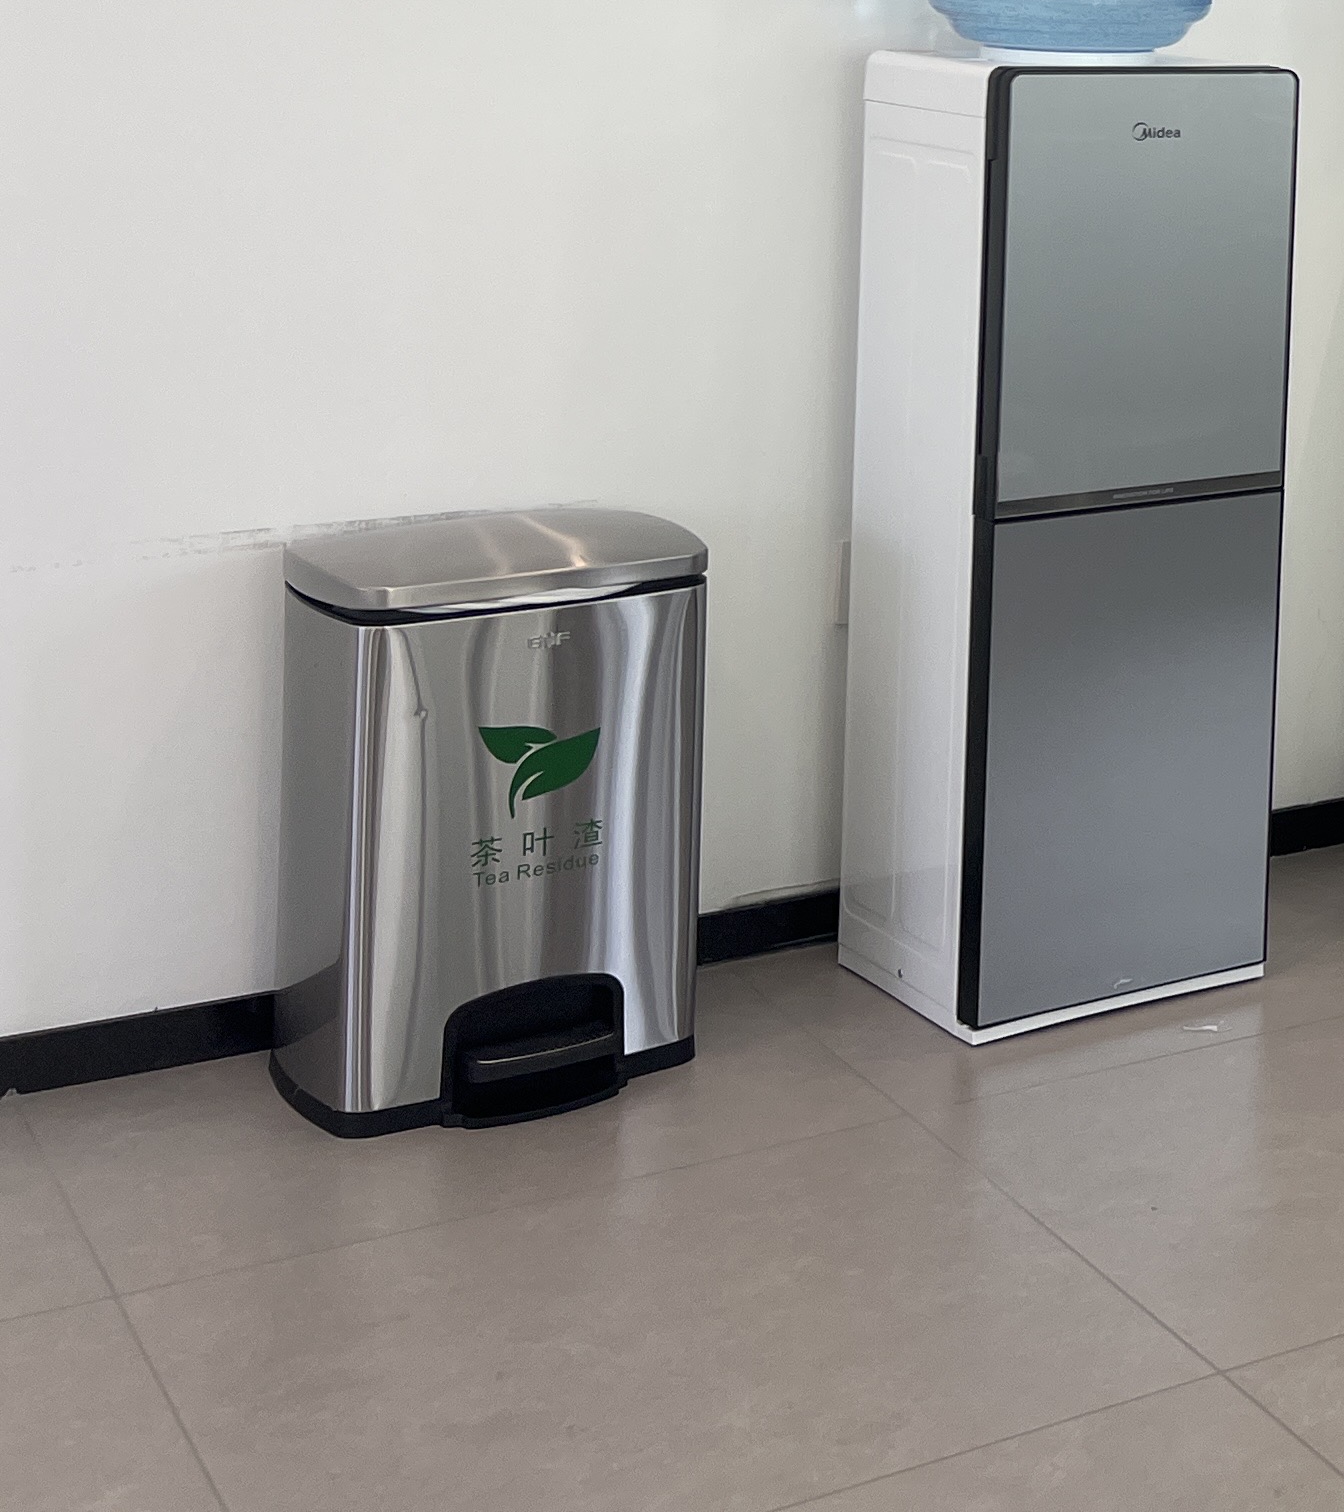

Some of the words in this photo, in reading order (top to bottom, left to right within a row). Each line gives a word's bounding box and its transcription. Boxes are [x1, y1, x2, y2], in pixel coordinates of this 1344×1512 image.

[1131, 122, 1181, 141] Midea
[473, 871, 509, 887] Tea
[517, 853, 599, 880] Residue
